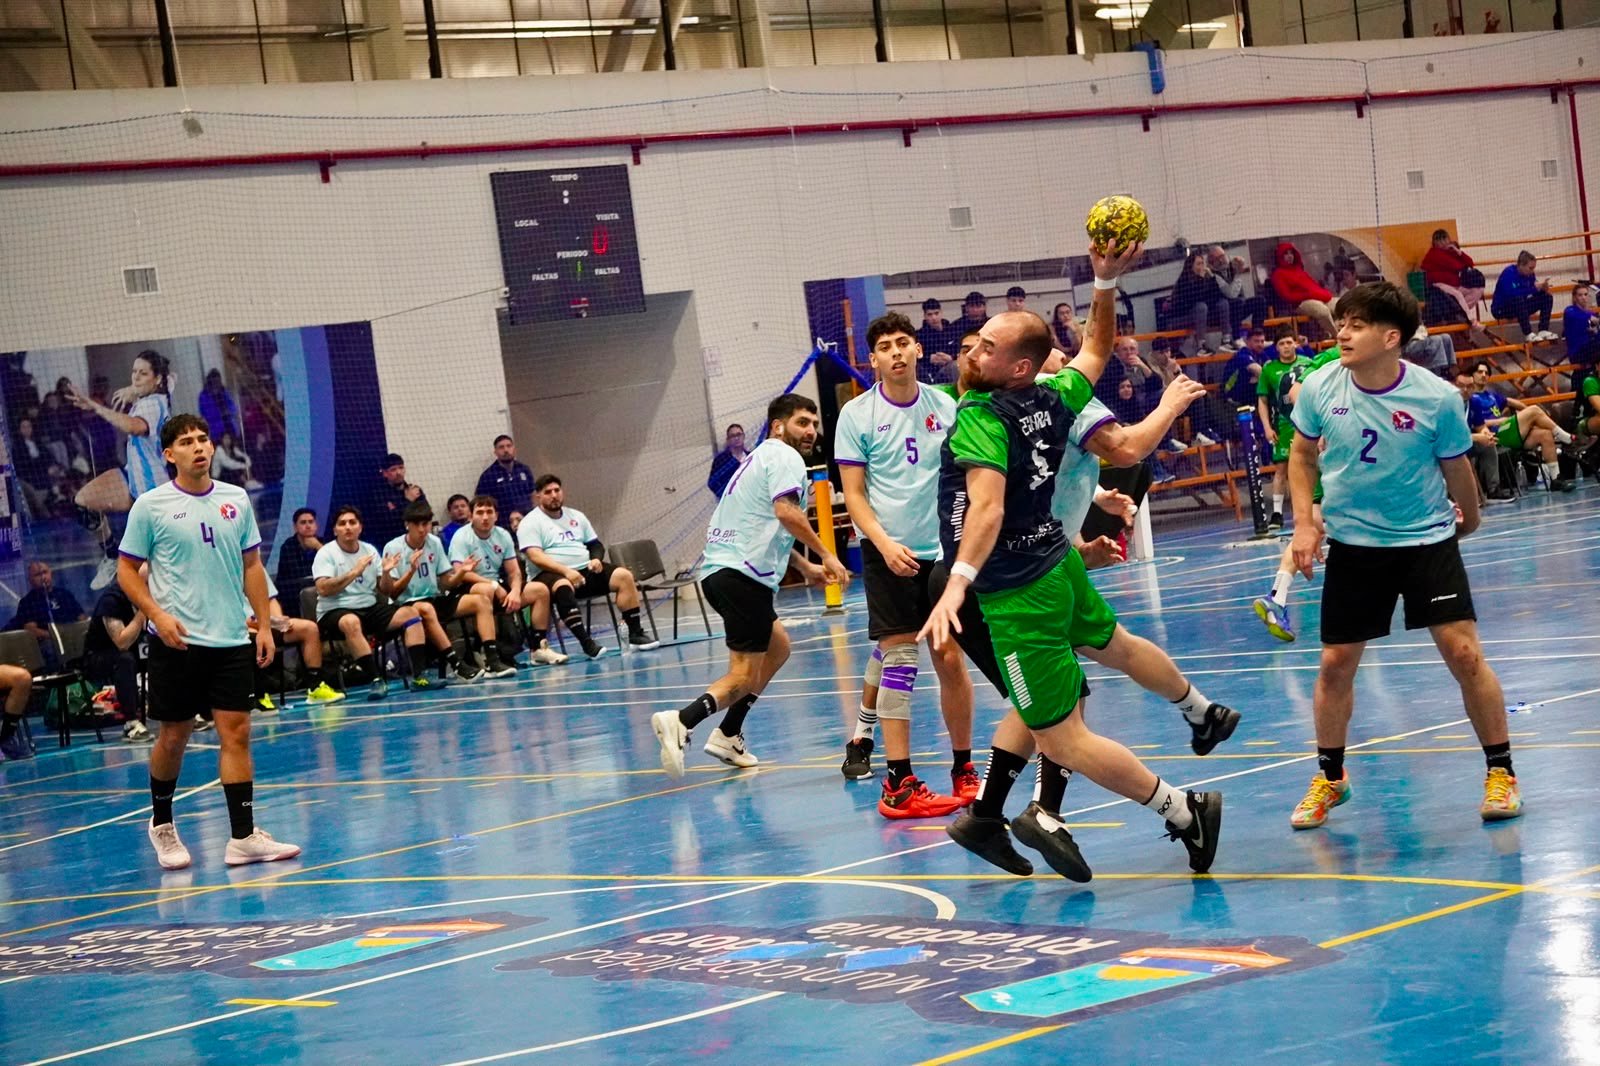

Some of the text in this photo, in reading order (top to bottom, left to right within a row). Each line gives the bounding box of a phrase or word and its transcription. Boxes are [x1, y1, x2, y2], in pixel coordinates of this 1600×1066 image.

[550, 173, 578, 181] TIEMPO
[514, 219, 539, 227] LOCAL
[595, 213, 620, 221] VISITA
[556, 250, 588, 259] PERIODO
[531, 272, 559, 281] FALTAS
[594, 266, 620, 275] FALTAS
[905, 437, 919, 465] 5
[1360, 428, 1378, 464] 2
[200, 522, 216, 549] 4
[416, 562, 429, 578] 10
[69, 923, 357, 944] Rivadavia
[806, 922, 1121, 955] Rivadavia
[212, 938, 295, 952] de
[939, 953, 1037, 973] de
[539, 949, 959, 994] Municipalidad
